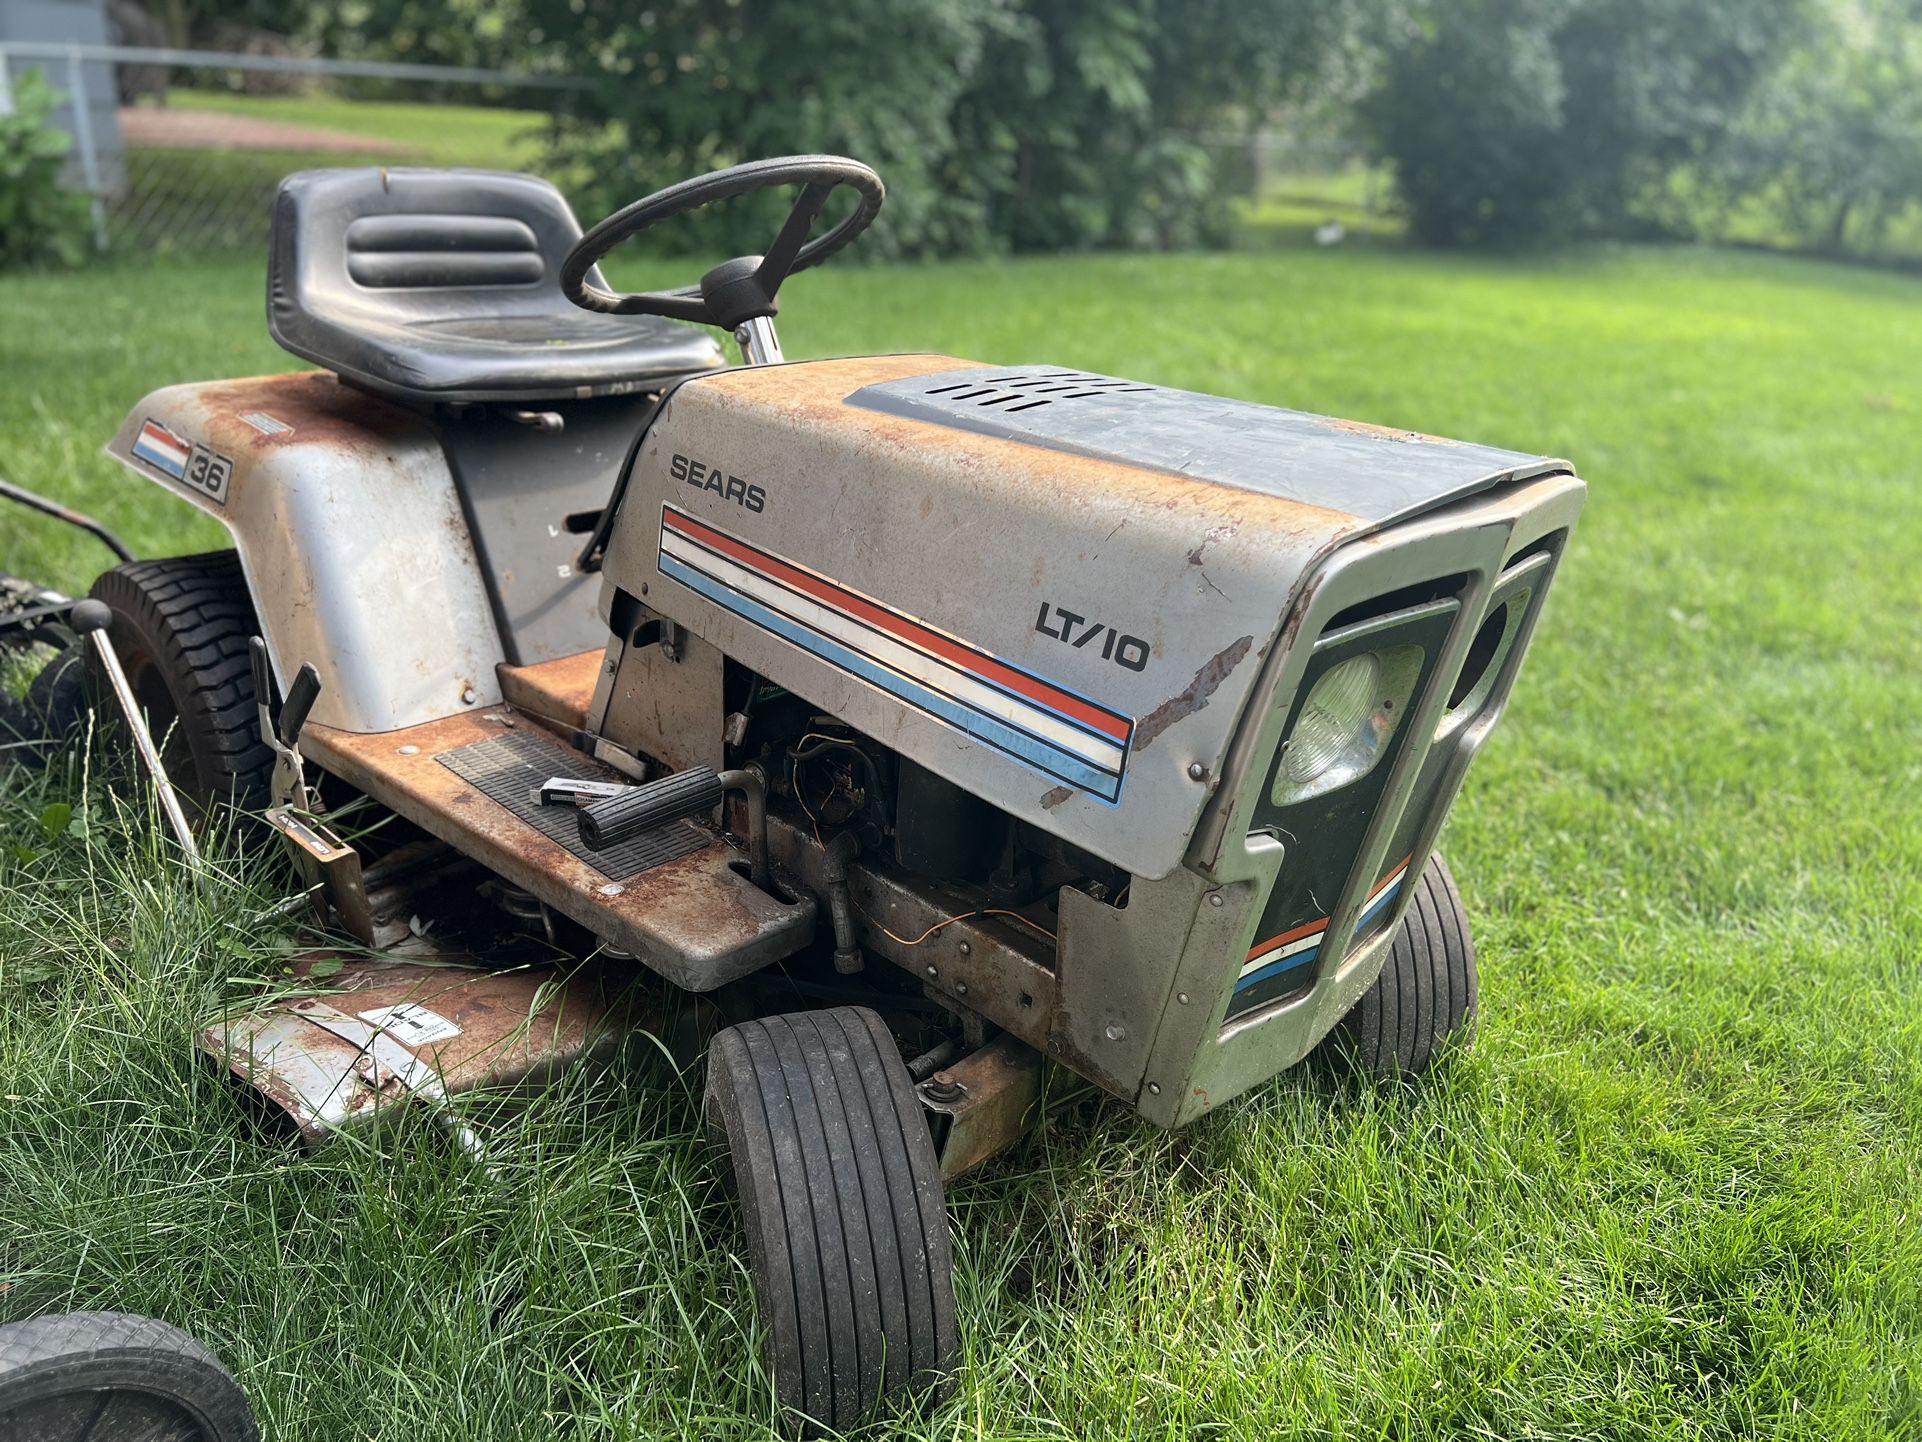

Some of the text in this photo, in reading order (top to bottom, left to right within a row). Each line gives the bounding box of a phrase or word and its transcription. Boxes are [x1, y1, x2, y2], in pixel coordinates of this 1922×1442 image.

[190, 456, 225, 493] 36
[670, 453, 766, 513] SEARS
[556, 564, 571, 578] 2
[1035, 601, 1150, 672] LT/10
